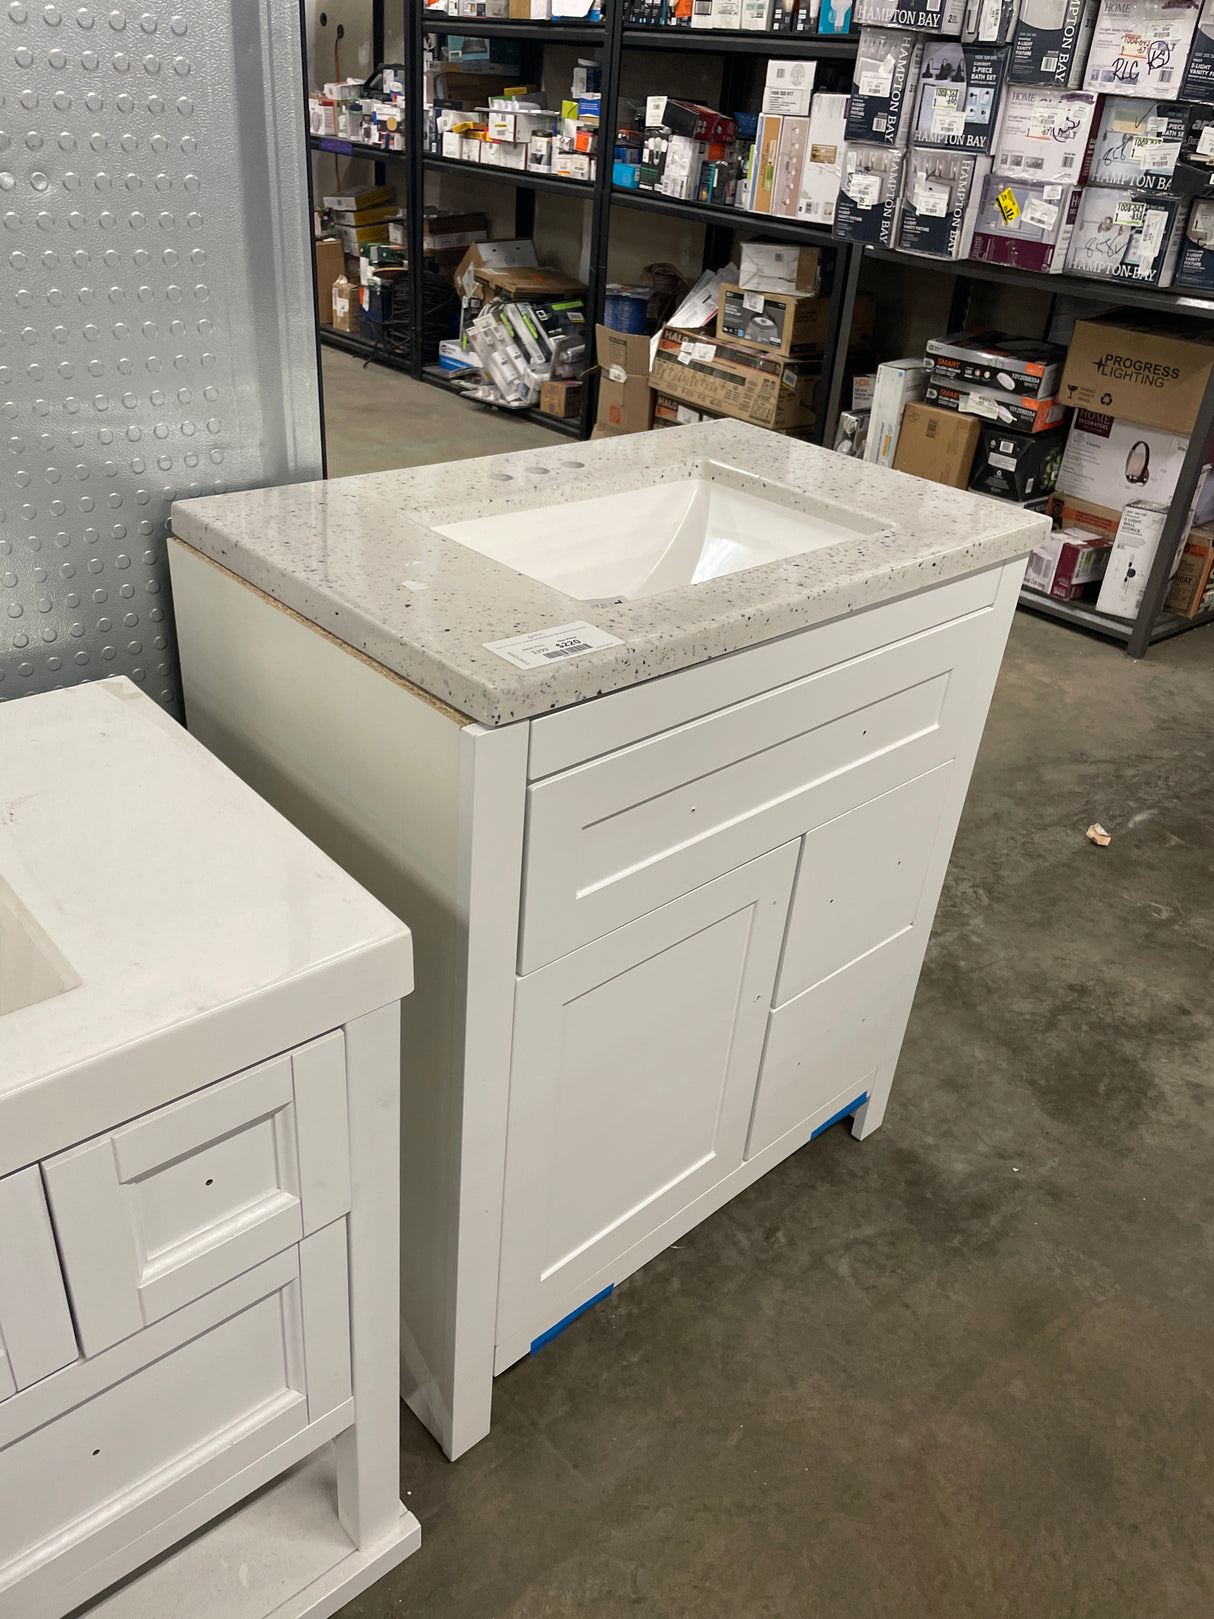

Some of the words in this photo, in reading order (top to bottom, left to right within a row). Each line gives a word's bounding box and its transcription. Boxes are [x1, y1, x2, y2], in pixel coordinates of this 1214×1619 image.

[858, 5, 917, 24] HAMPTON
[918, 11, 941, 27] BAY
[1104, 3, 1132, 13] HOME
[889, 37, 912, 113] HAMPTON
[972, 66, 993, 74] 5-PIECE
[1055, 53, 1070, 82] BAY
[1189, 68, 1210, 76] VANITY
[971, 73, 986, 81] BATH
[1012, 92, 1037, 103] HOME
[884, 115, 897, 144] BAY
[914, 130, 966, 146] HAMPTON
[966, 134, 987, 148] BAY
[883, 152, 901, 218] HAMPTON
[1091, 172, 1155, 189] HAMPTON
[951, 160, 970, 228] HAMPTON
[879, 219, 891, 244] BAY
[1068, 260, 1130, 278] HAMPTON
[664, 329, 689, 343] HALO
[937, 357, 961, 369] SMART
[1104, 353, 1181, 380] PROGRESS
[1101, 364, 1165, 389] LIGHTING
[940, 388, 961, 398] SMART
[657, 396, 678, 410] HALO
[1079, 408, 1111, 425] HOME
